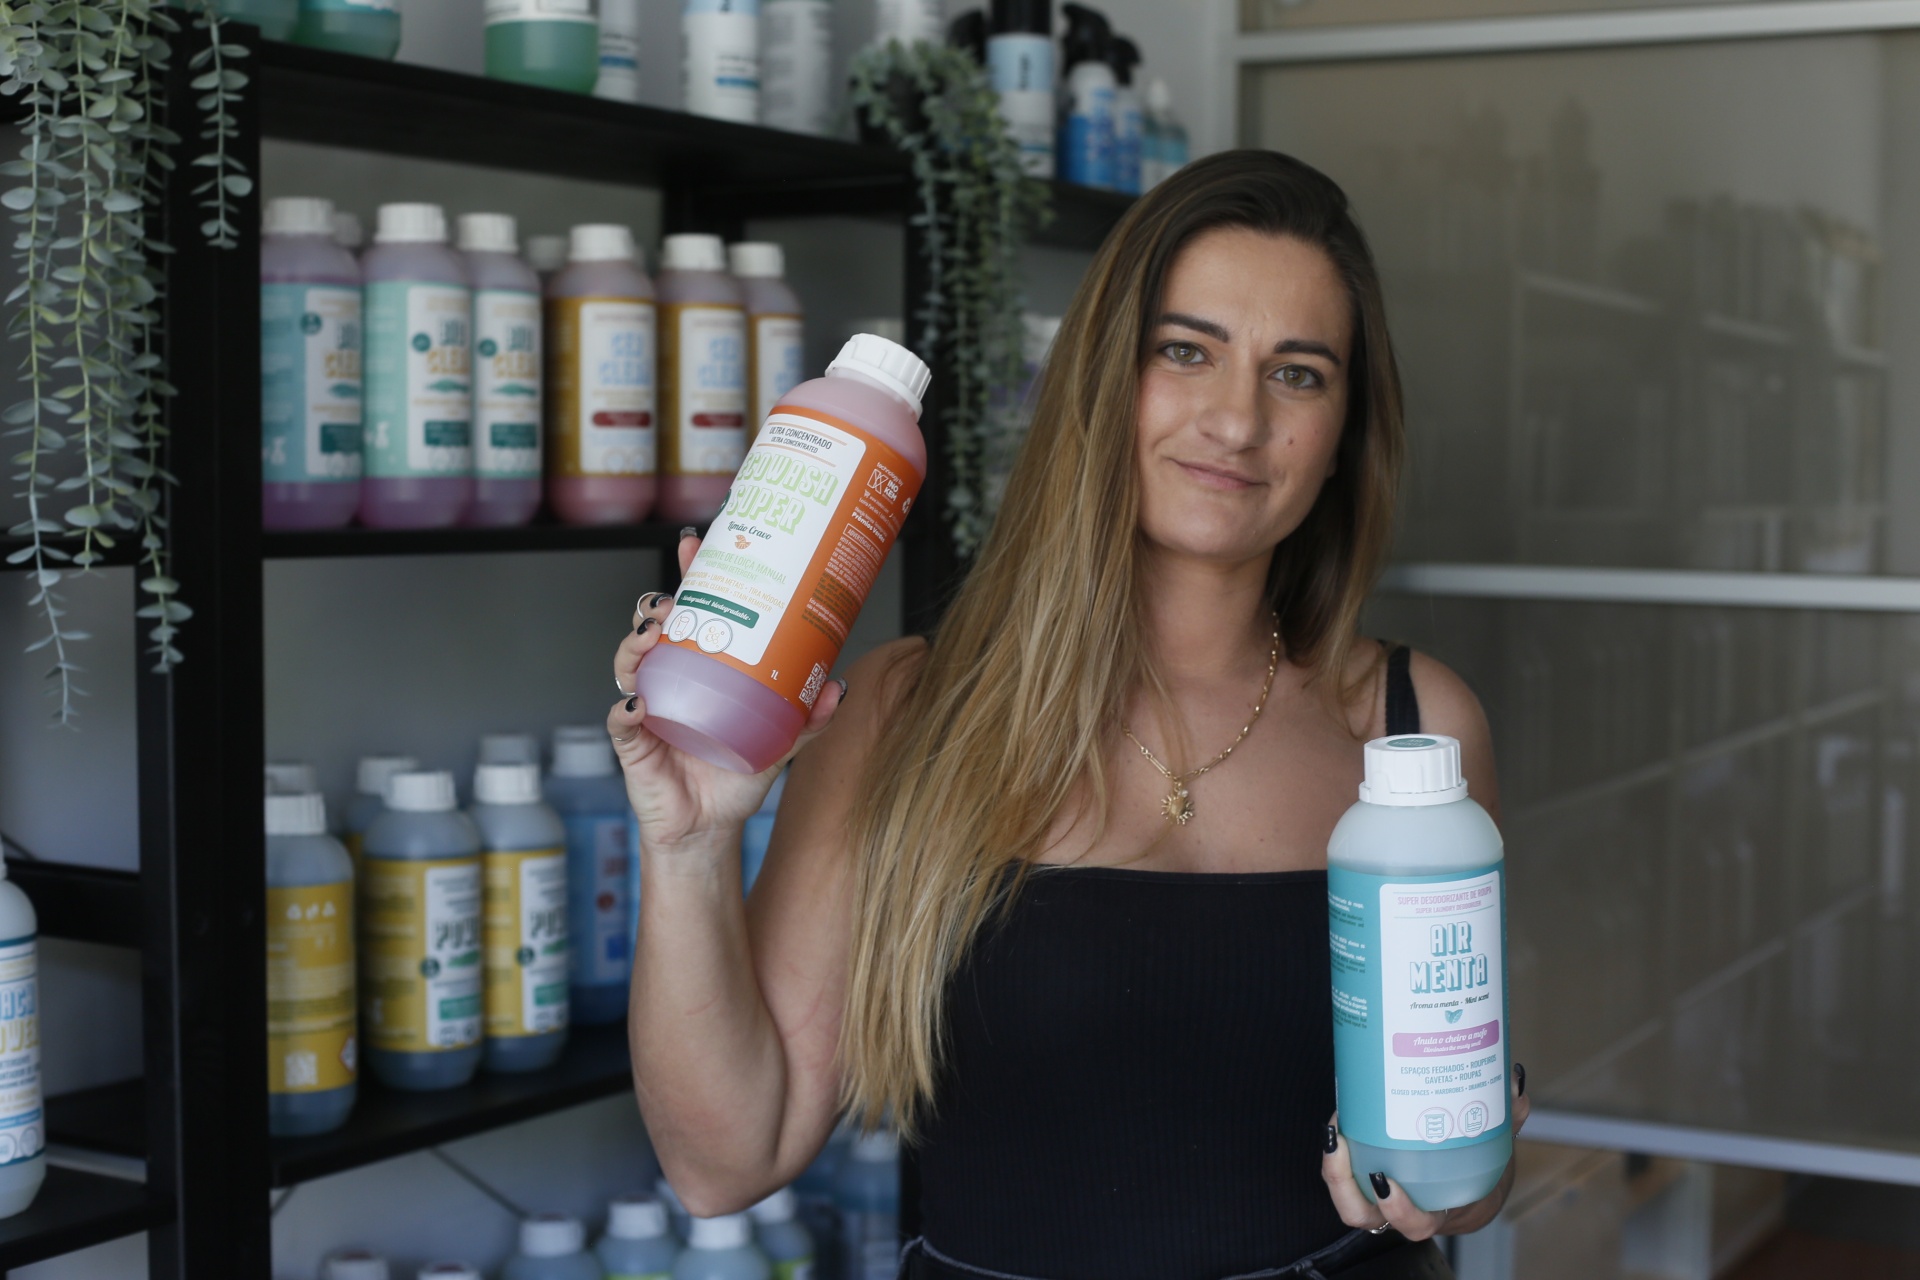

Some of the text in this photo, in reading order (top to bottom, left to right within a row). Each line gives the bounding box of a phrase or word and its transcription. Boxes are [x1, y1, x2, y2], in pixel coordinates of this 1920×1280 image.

[769, 426, 833, 450] ULTRA CONCENTRADO
[771, 436, 819, 454] ULTRA CONCENTRATED
[737, 452, 839, 507] ECOWASH
[887, 479, 899, 493] INO
[726, 484, 806, 536] SUPER
[728, 520, 772, 541] Limão Cravo
[851, 511, 873, 531] Prémios
[724, 552, 735, 562] DE
[733, 554, 756, 570] LOIÇA
[755, 563, 787, 585] MANUAL
[724, 575, 745, 590] METAIS
[748, 586, 762, 597] TIRA
[748, 596, 773, 613] REMOVER
[770, 669, 779, 681] 1L
[1398, 896, 1419, 906] SUPER
[1420, 892, 1469, 905] DESODORIZANTE
[1470, 890, 1478, 900] DE
[1433, 905, 1456, 914] LAUNDRY
[1430, 920, 1472, 957] AIR
[1409, 953, 1488, 994] MENTA
[1410, 1001, 1433, 1010] Aroma
[1440, 1000, 1459, 1008] menta
[1464, 996, 1477, 1005] Mint
[1413, 1036, 1438, 1047] Anula
[1445, 1033, 1467, 1043] cheiro
[1472, 1028, 1488, 1039] mofo
[1400, 1054, 1497, 1077] ESPAÇOS FECHADOS ROUPEIROS
[1424, 1069, 1482, 1085] GAVETAS ROUPAS
[1390, 1088, 1410, 1096] CLOSED
[1434, 1086, 1465, 1095] WARDROBES
[1468, 1080, 1487, 1091] DRAWERS
